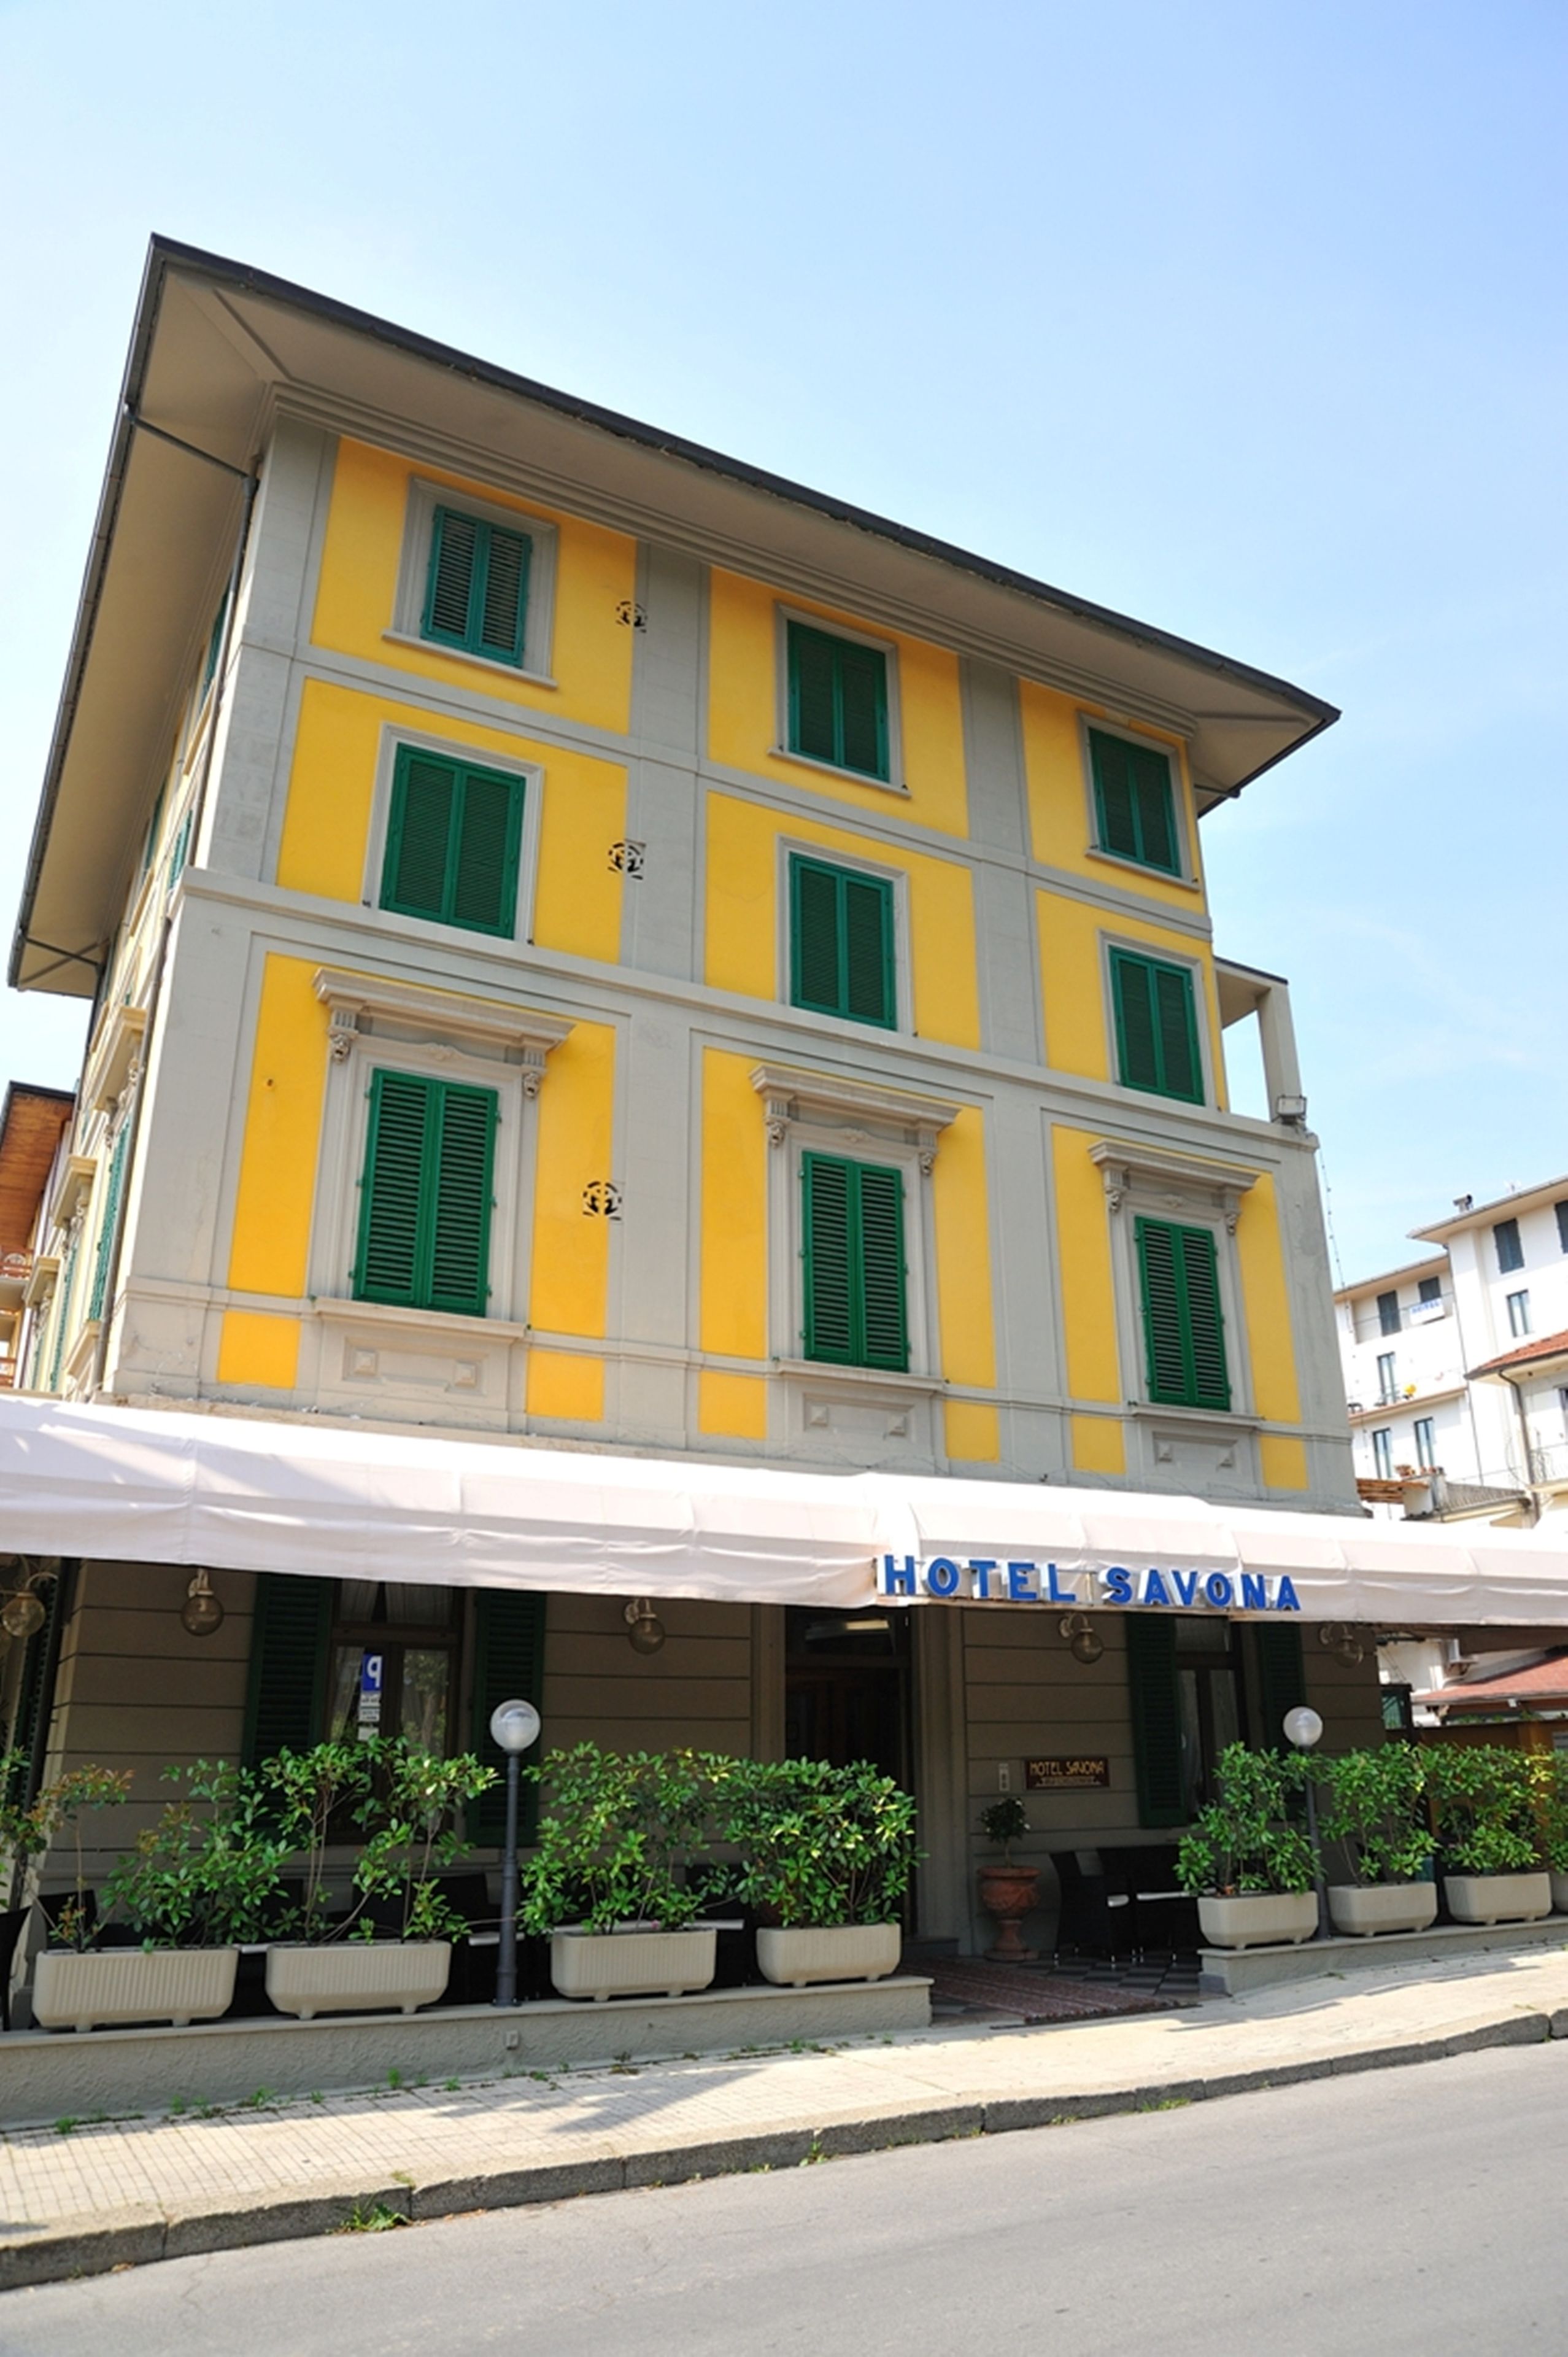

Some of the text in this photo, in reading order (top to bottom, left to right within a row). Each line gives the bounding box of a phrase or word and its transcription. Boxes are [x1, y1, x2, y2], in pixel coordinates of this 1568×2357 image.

[882, 1554, 1301, 1611] HOTEL SAVONA
[1030, 1760, 1104, 1776] HOTEL SAVONA
